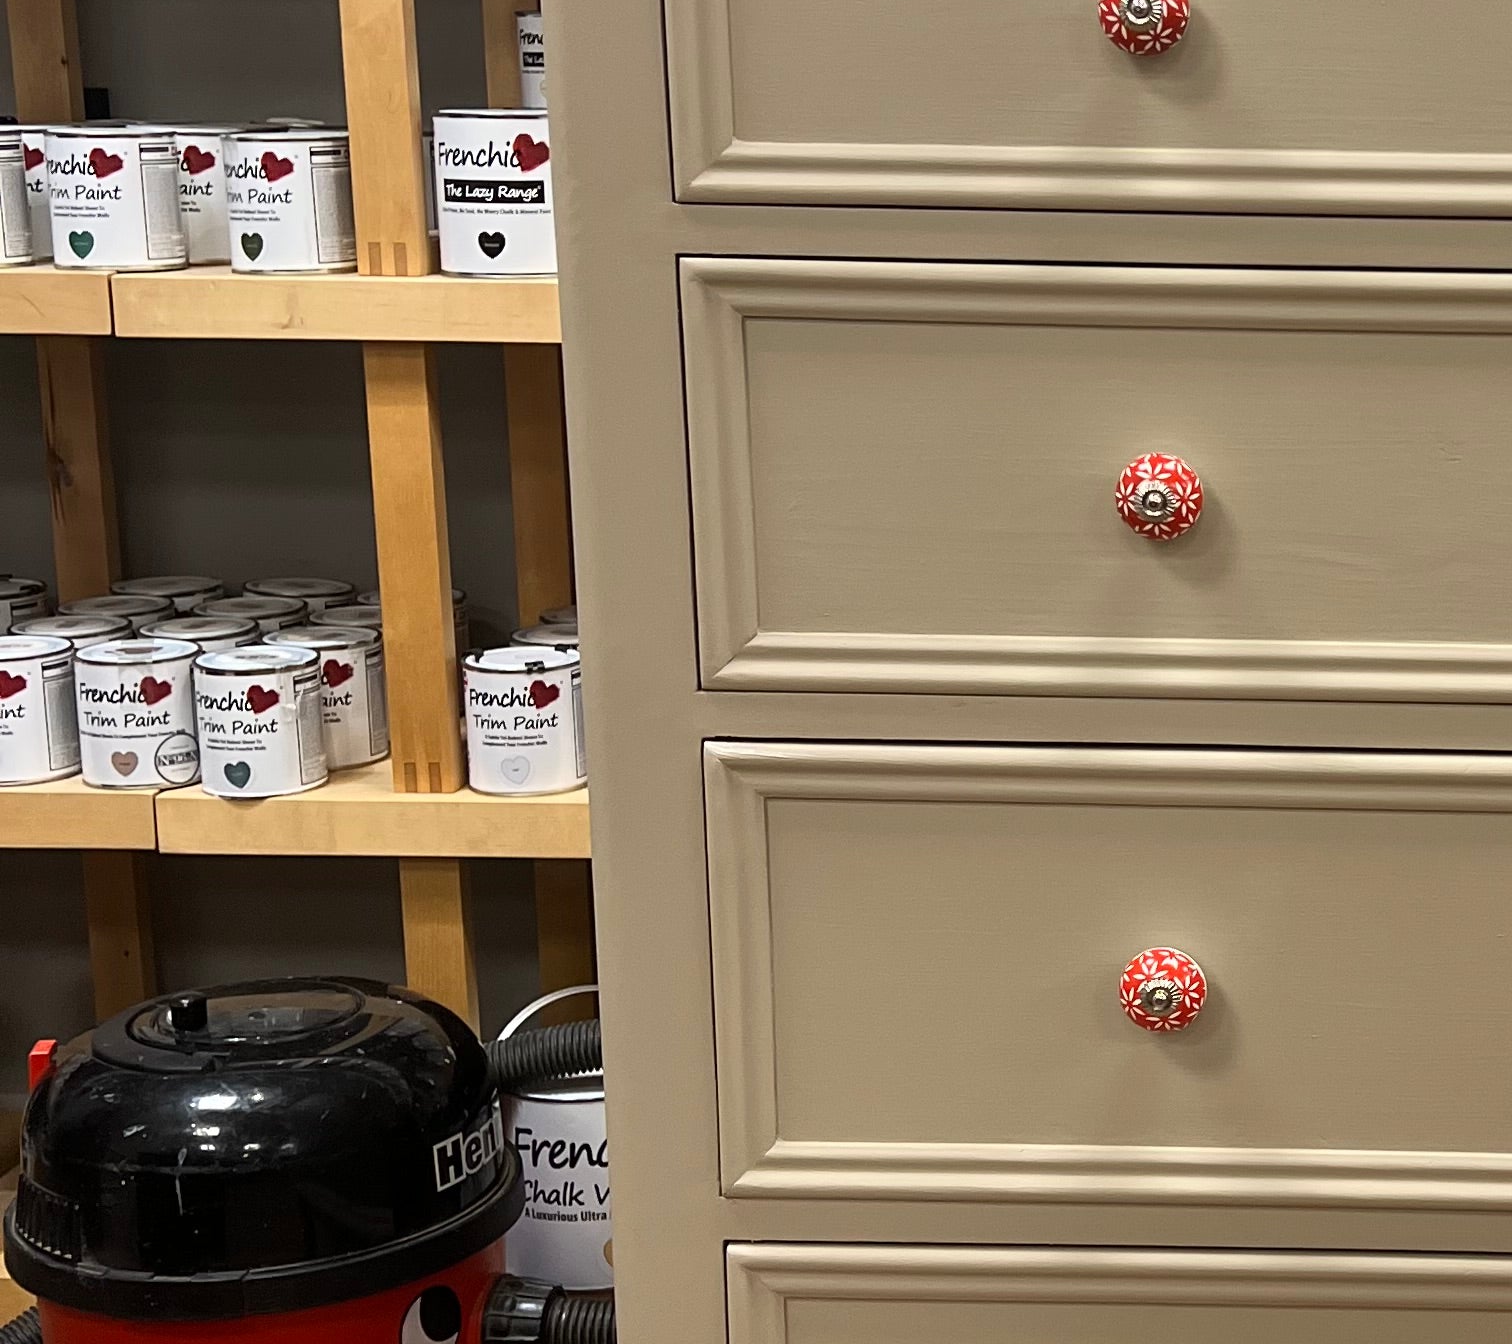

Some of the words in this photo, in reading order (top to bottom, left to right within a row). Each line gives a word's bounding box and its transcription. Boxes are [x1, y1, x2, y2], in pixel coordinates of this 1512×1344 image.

[438, 141, 522, 167] Frenchic
[75, 184, 123, 200] Paint
[180, 179, 213, 196] aint
[248, 187, 293, 204] Paint
[446, 183, 463, 197] The
[465, 183, 494, 203] Lazy
[498, 185, 539, 199] Range
[80, 682, 147, 704] Frenchic
[322, 691, 352, 707] aint
[470, 686, 537, 708] Frenchic
[84, 710, 117, 728] Trim
[124, 710, 171, 728] Paint
[232, 718, 279, 735] Paint
[473, 713, 507, 730] Trim
[514, 713, 559, 730] Paint
[515, 1127, 609, 1169] Frenc
[532, 1208, 578, 1223] Luxurious
[580, 1211, 607, 1222] Ultra
